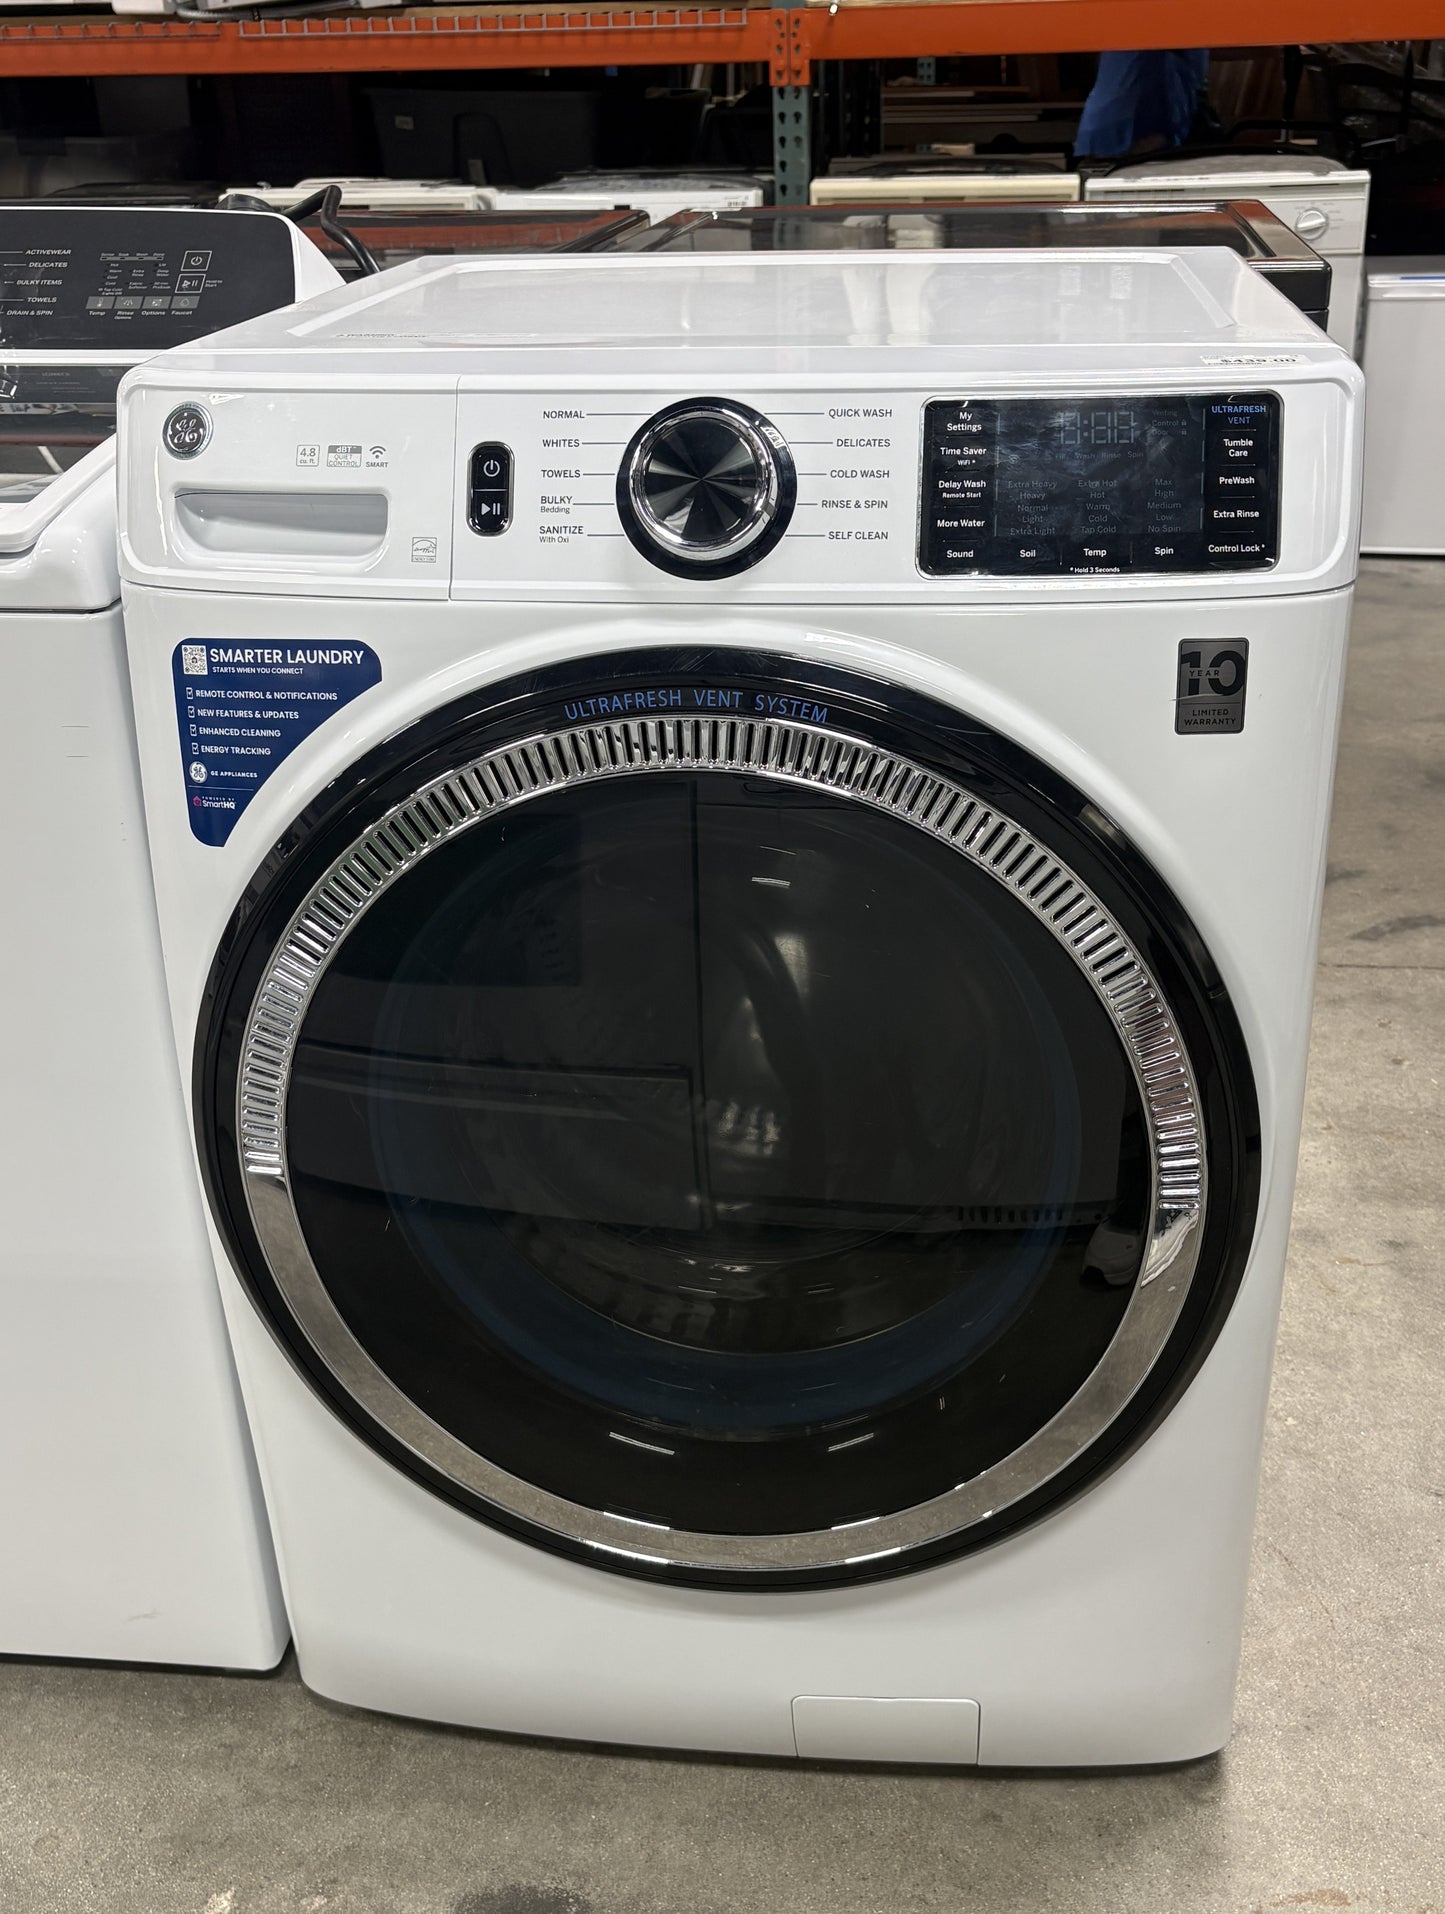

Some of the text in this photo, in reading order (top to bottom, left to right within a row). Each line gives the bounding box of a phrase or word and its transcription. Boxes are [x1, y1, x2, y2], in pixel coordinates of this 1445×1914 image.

[1211, 405, 1267, 413] ULTRAFRESH
[543, 411, 585, 419] NORMAL
[828, 409, 893, 419] QUICK WASH
[959, 412, 972, 421] My
[1228, 416, 1251, 424] VENT
[946, 423, 982, 432] Settings
[542, 439, 580, 448] WHITES
[836, 439, 891, 448] DELICATES
[1223, 438, 1254, 446] Tumble
[300, 447, 316, 457] 4.8
[940, 447, 987, 455] Time Saver
[1228, 449, 1248, 457] Care
[541, 470, 581, 478] TOWELS
[830, 470, 890, 478] COLD WASH
[938, 480, 986, 489] Delay Wash
[1008, 480, 1057, 489] Extra Heavy
[1219, 476, 1255, 484] PreWash
[540, 496, 573, 504] BULKY
[1020, 492, 1046, 500] Heavy
[821, 500, 888, 508] RINSE & SPIN
[1017, 504, 1049, 512] Normal
[540, 506, 570, 514] Bedding
[1213, 510, 1260, 518] Extra Rinse
[937, 519, 985, 528] More Water
[1022, 515, 1043, 524] Light
[1088, 515, 1108, 523] Cold
[539, 526, 584, 535] SANITIZE
[1010, 527, 1032, 536] Extra
[1162, 525, 1181, 533] Spin
[828, 531, 889, 540] SELF CLEAN
[1083, 548, 1107, 557] Temp
[1154, 547, 1174, 555] Spin
[1208, 544, 1260, 553] Control Lock
[946, 549, 974, 558] Sound
[1020, 549, 1036, 558] Soil
[210, 649, 364, 664] SMARTER LAUNDRY
[1181, 650, 1246, 696] 10
[196, 690, 226, 698] REMOTE
[226, 691, 264, 699] CONTROL
[274, 691, 338, 700] NOTIFICATIONS
[565, 689, 829, 724] ULTRAFRESH VENT SYSTEM
[197, 709, 299, 719] NEW FEATURES & UPDATES
[1192, 708, 1229, 717] LIMITED
[1184, 718, 1236, 726] WARRANTY
[199, 727, 281, 737] ENHANCED CLEANING
[201, 745, 271, 755] ENERGY TRACKING
[202, 800, 235, 810] SmartHQ
